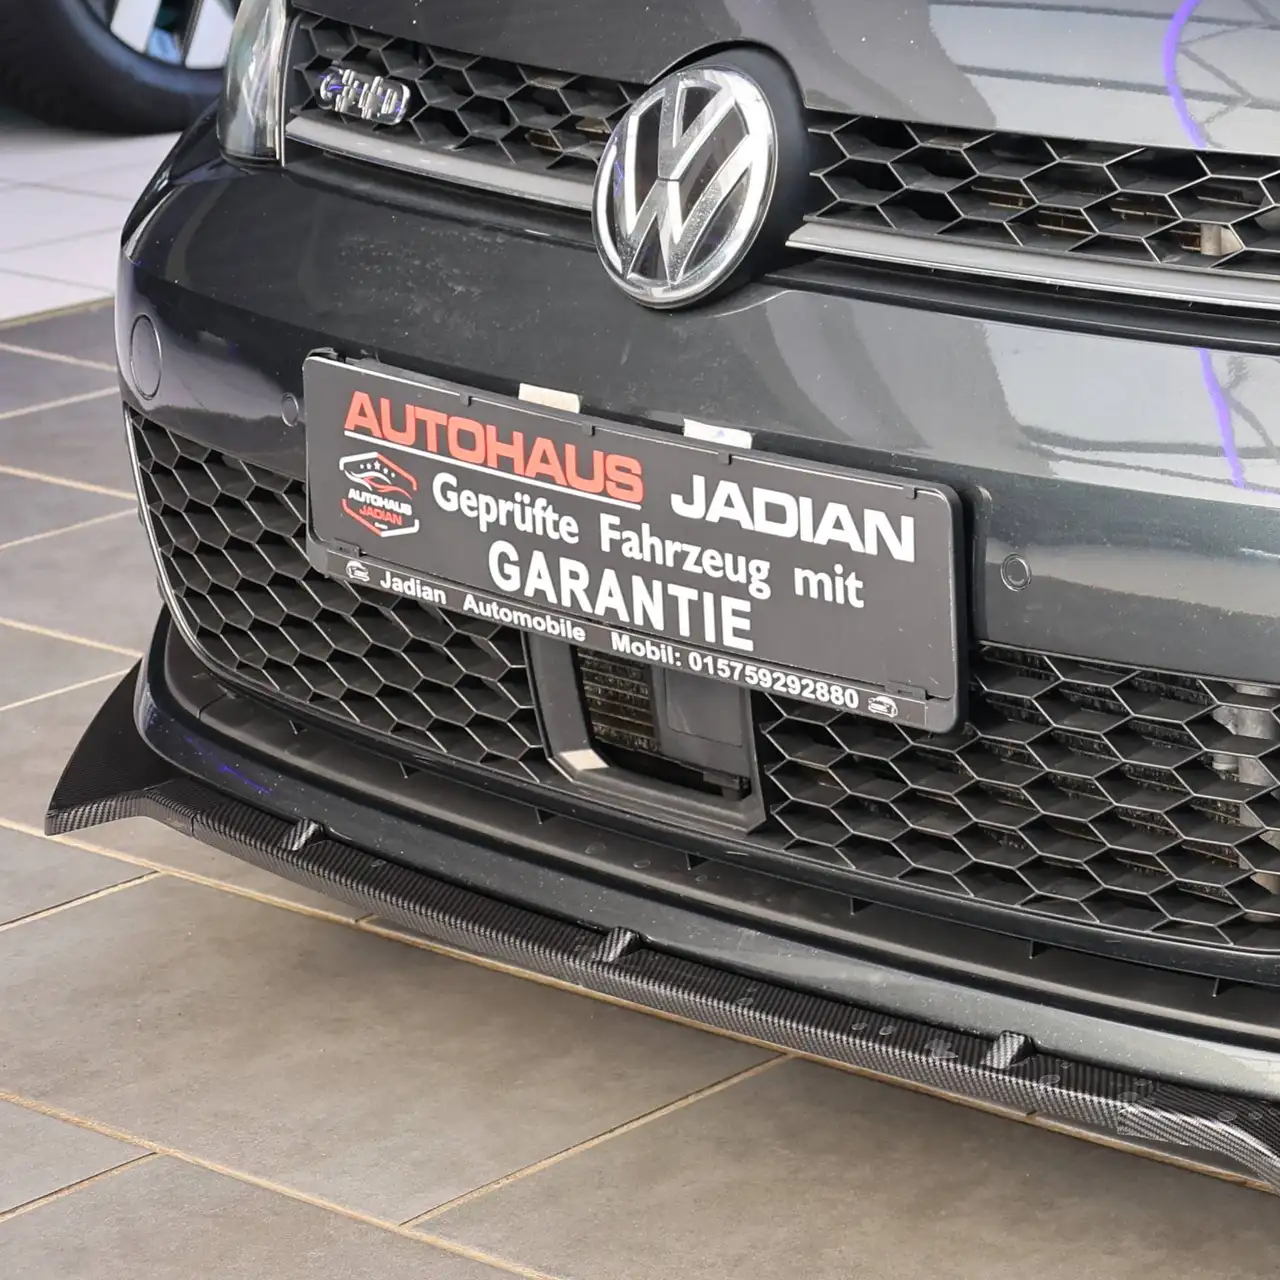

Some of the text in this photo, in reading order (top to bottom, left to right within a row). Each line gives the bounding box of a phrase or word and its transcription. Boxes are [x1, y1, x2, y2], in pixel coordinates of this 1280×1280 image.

[344, 390, 915, 563] AUTOHAUS JADIAN
[348, 487, 413, 516] AUTOHAUS
[359, 505, 403, 526] JADIAN
[432, 472, 865, 609] Geprüfte Fahrzeug mit
[488, 539, 754, 652] GARANTIE
[380, 571, 860, 709] Jadian Automobile Mobil: 015759292880
